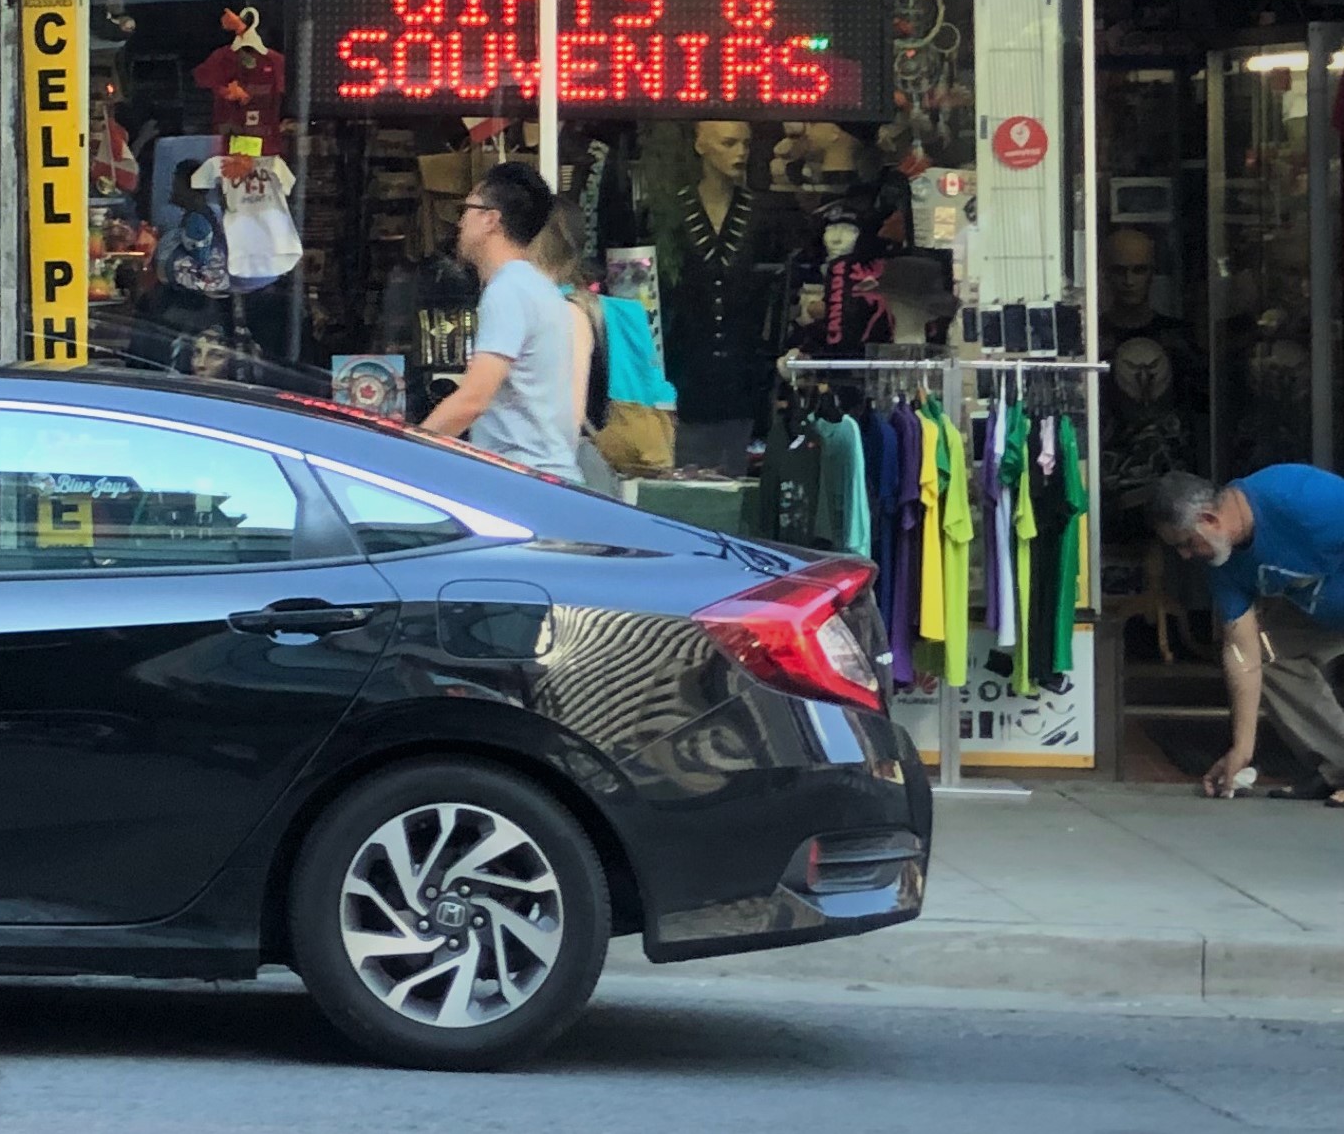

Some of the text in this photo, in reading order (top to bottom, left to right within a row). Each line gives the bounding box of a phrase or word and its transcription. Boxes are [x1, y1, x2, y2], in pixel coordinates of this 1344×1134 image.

[337, 29, 833, 105] SOUVENIRS
[34, 12, 71, 224] CELL
[826, 261, 847, 345] CANADA
[55, 474, 131, 499] Blue Jays
